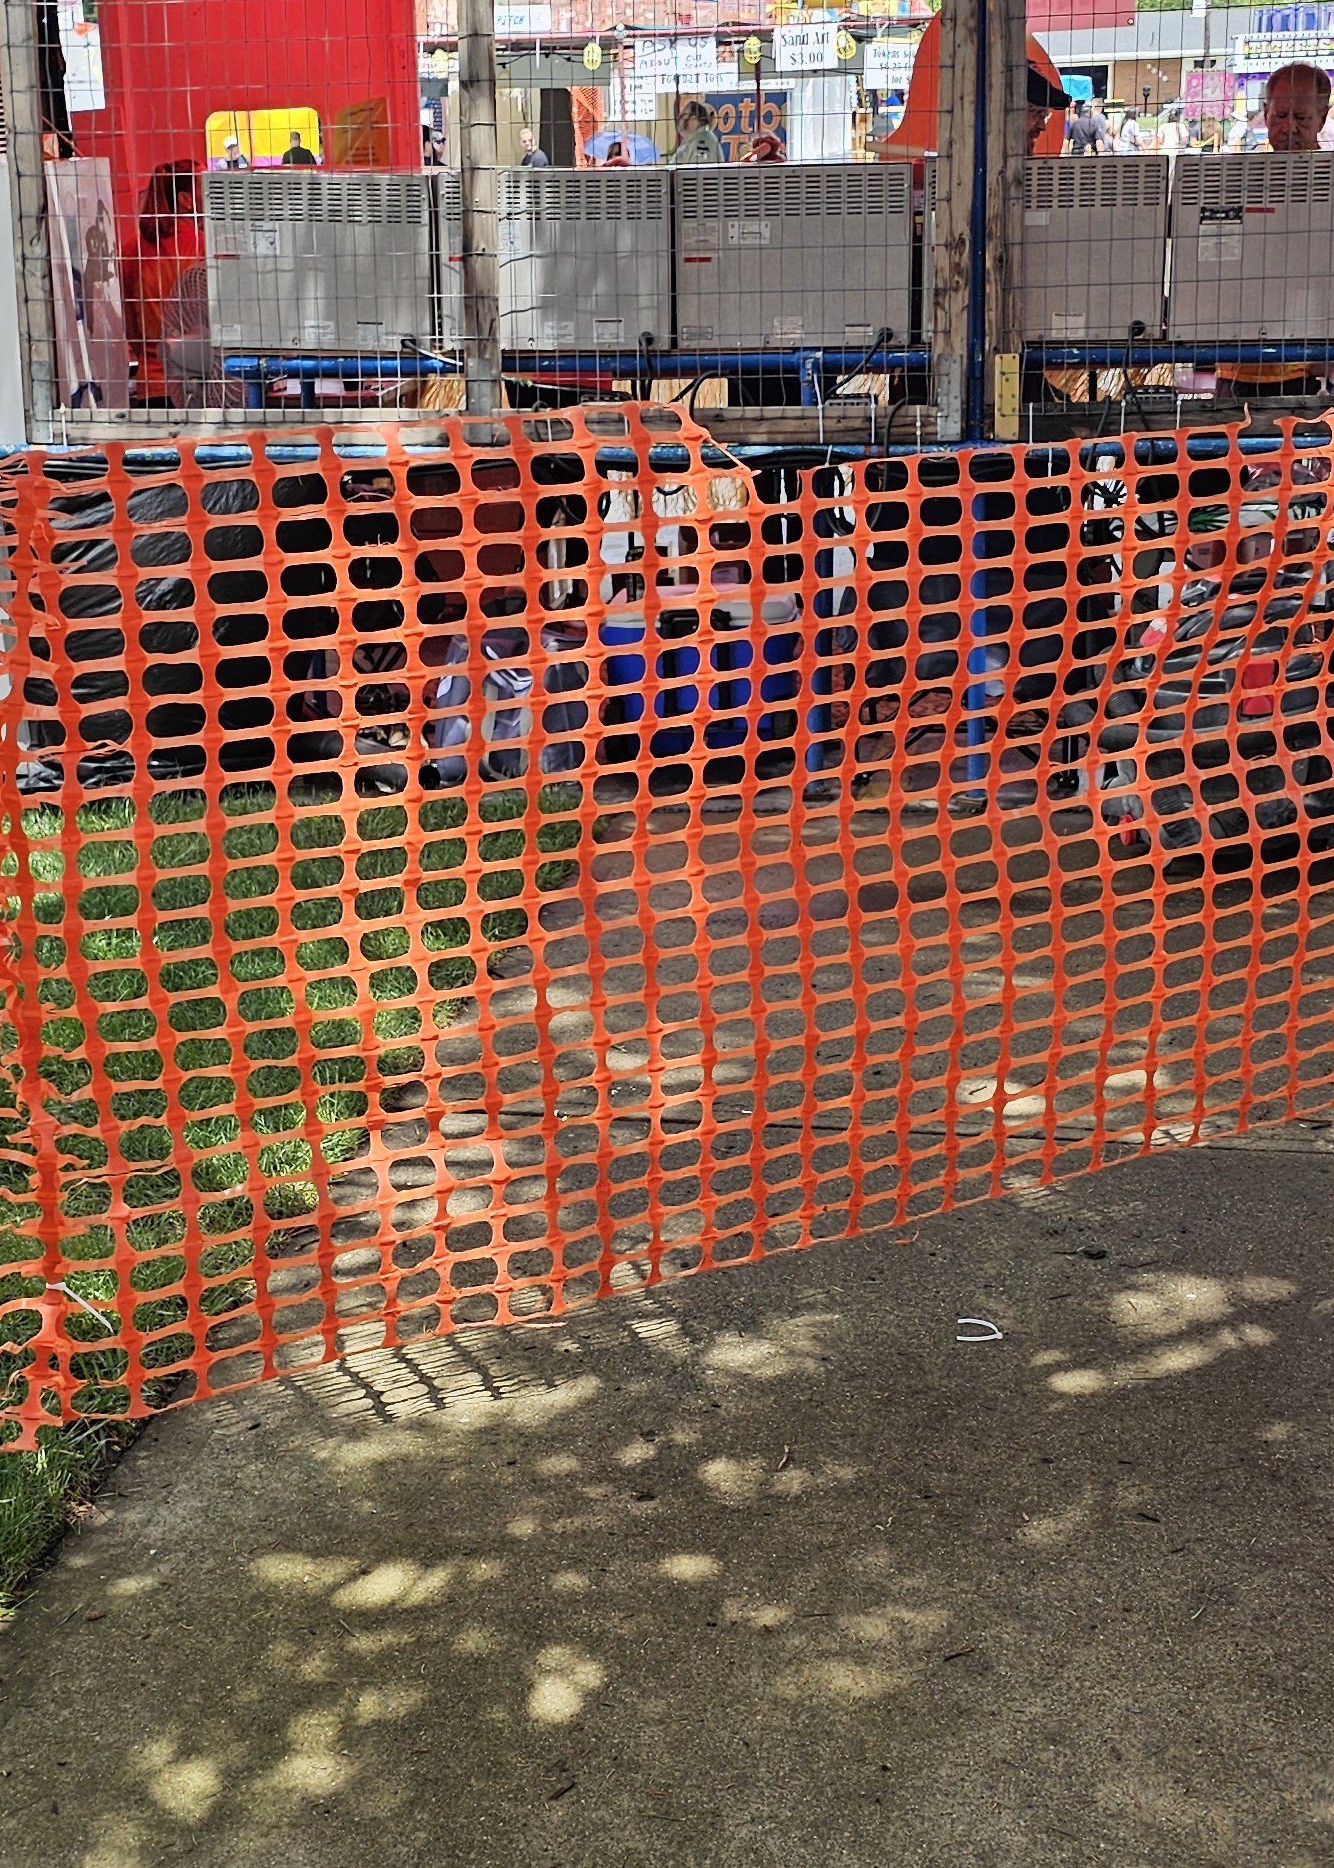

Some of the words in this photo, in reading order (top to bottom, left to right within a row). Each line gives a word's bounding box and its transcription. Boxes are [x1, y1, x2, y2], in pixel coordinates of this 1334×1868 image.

[688, 37, 708, 48] US
[781, 31, 809, 47] Sand
[813, 31, 830, 45] Art
[790, 50, 824, 65] $3.00
